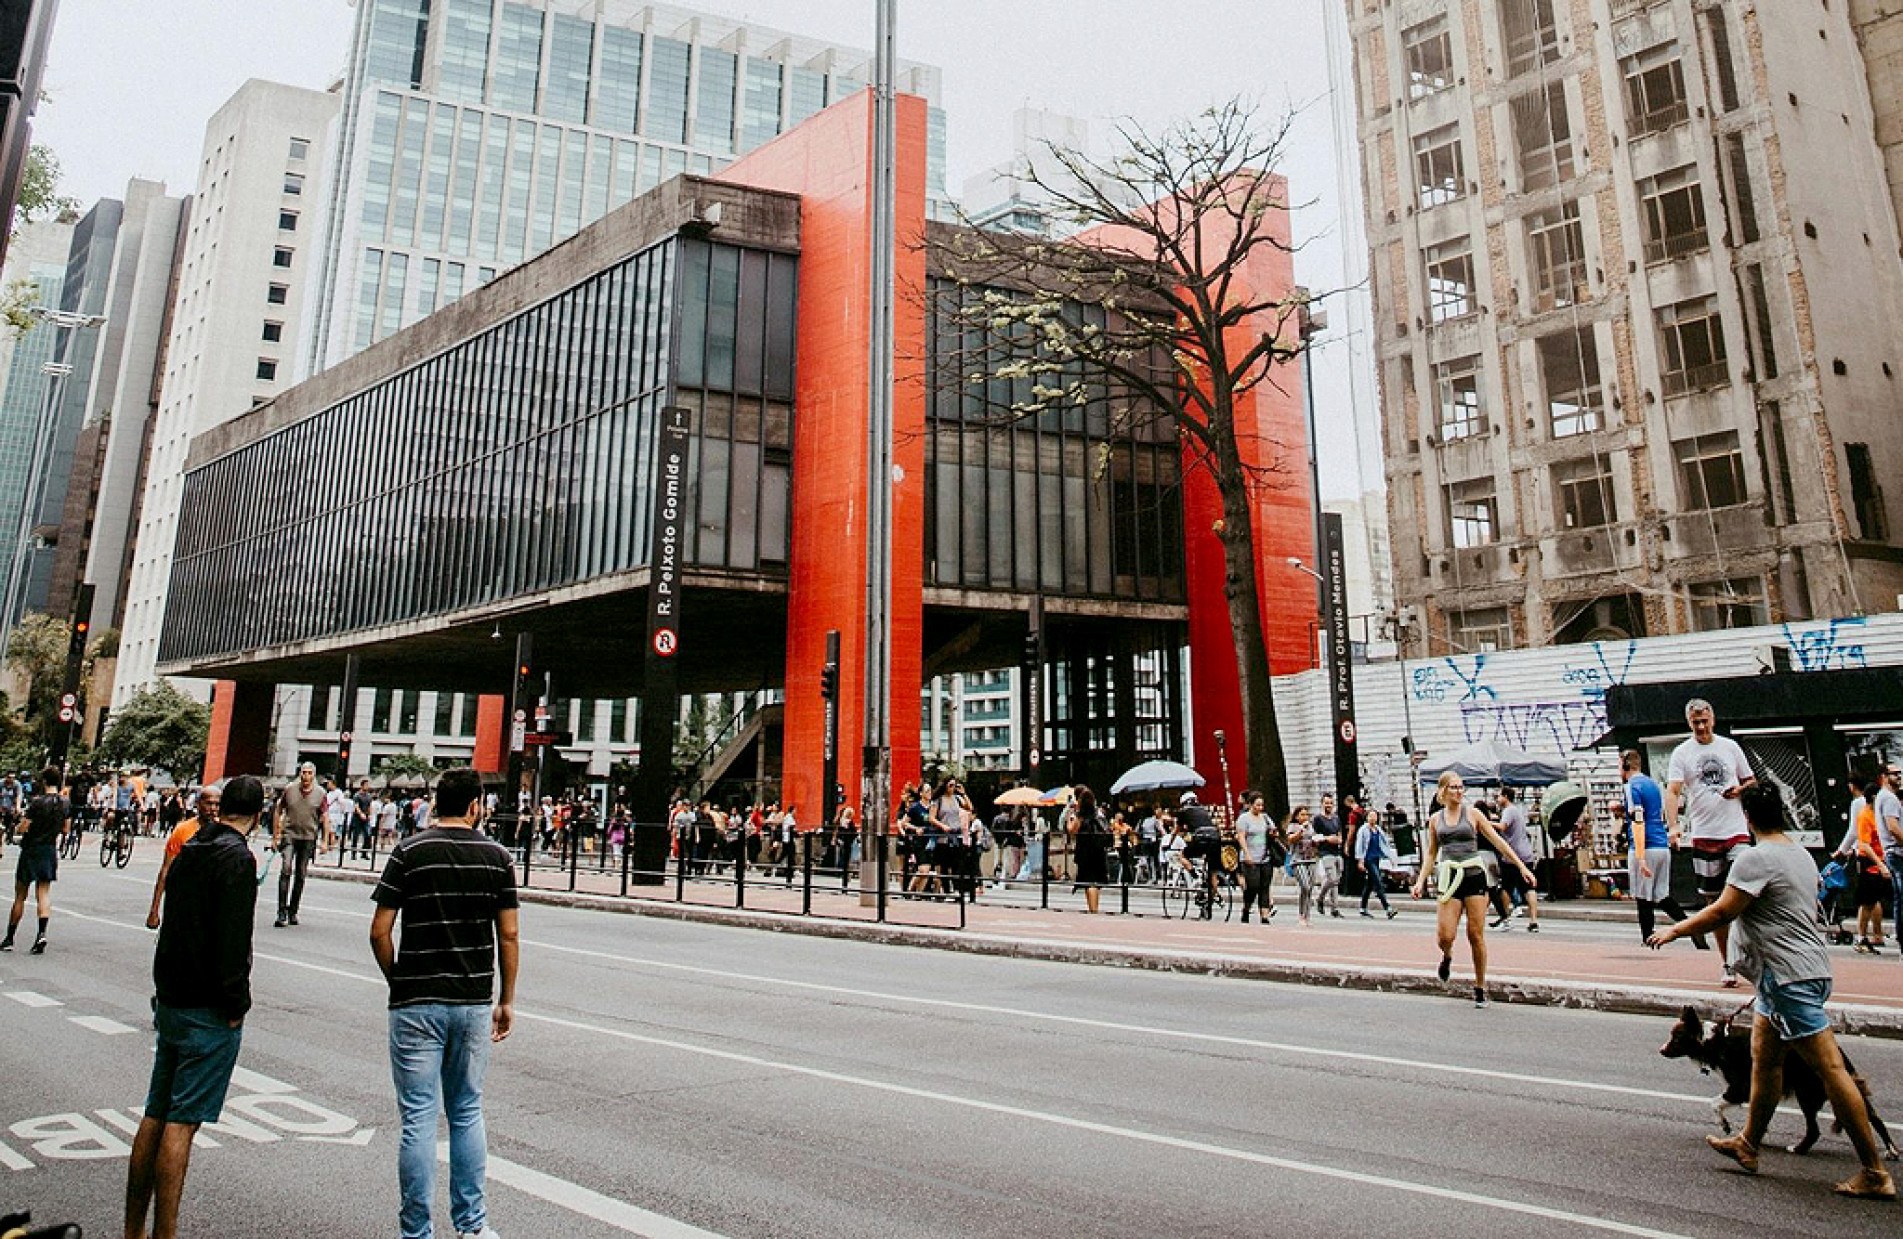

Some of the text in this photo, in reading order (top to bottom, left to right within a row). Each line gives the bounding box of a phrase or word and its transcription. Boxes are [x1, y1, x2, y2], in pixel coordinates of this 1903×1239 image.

[657, 453, 681, 616] R. Peixoto Gomide
[1331, 550, 1341, 604] Mendes
[1339, 696, 1349, 711] R.
